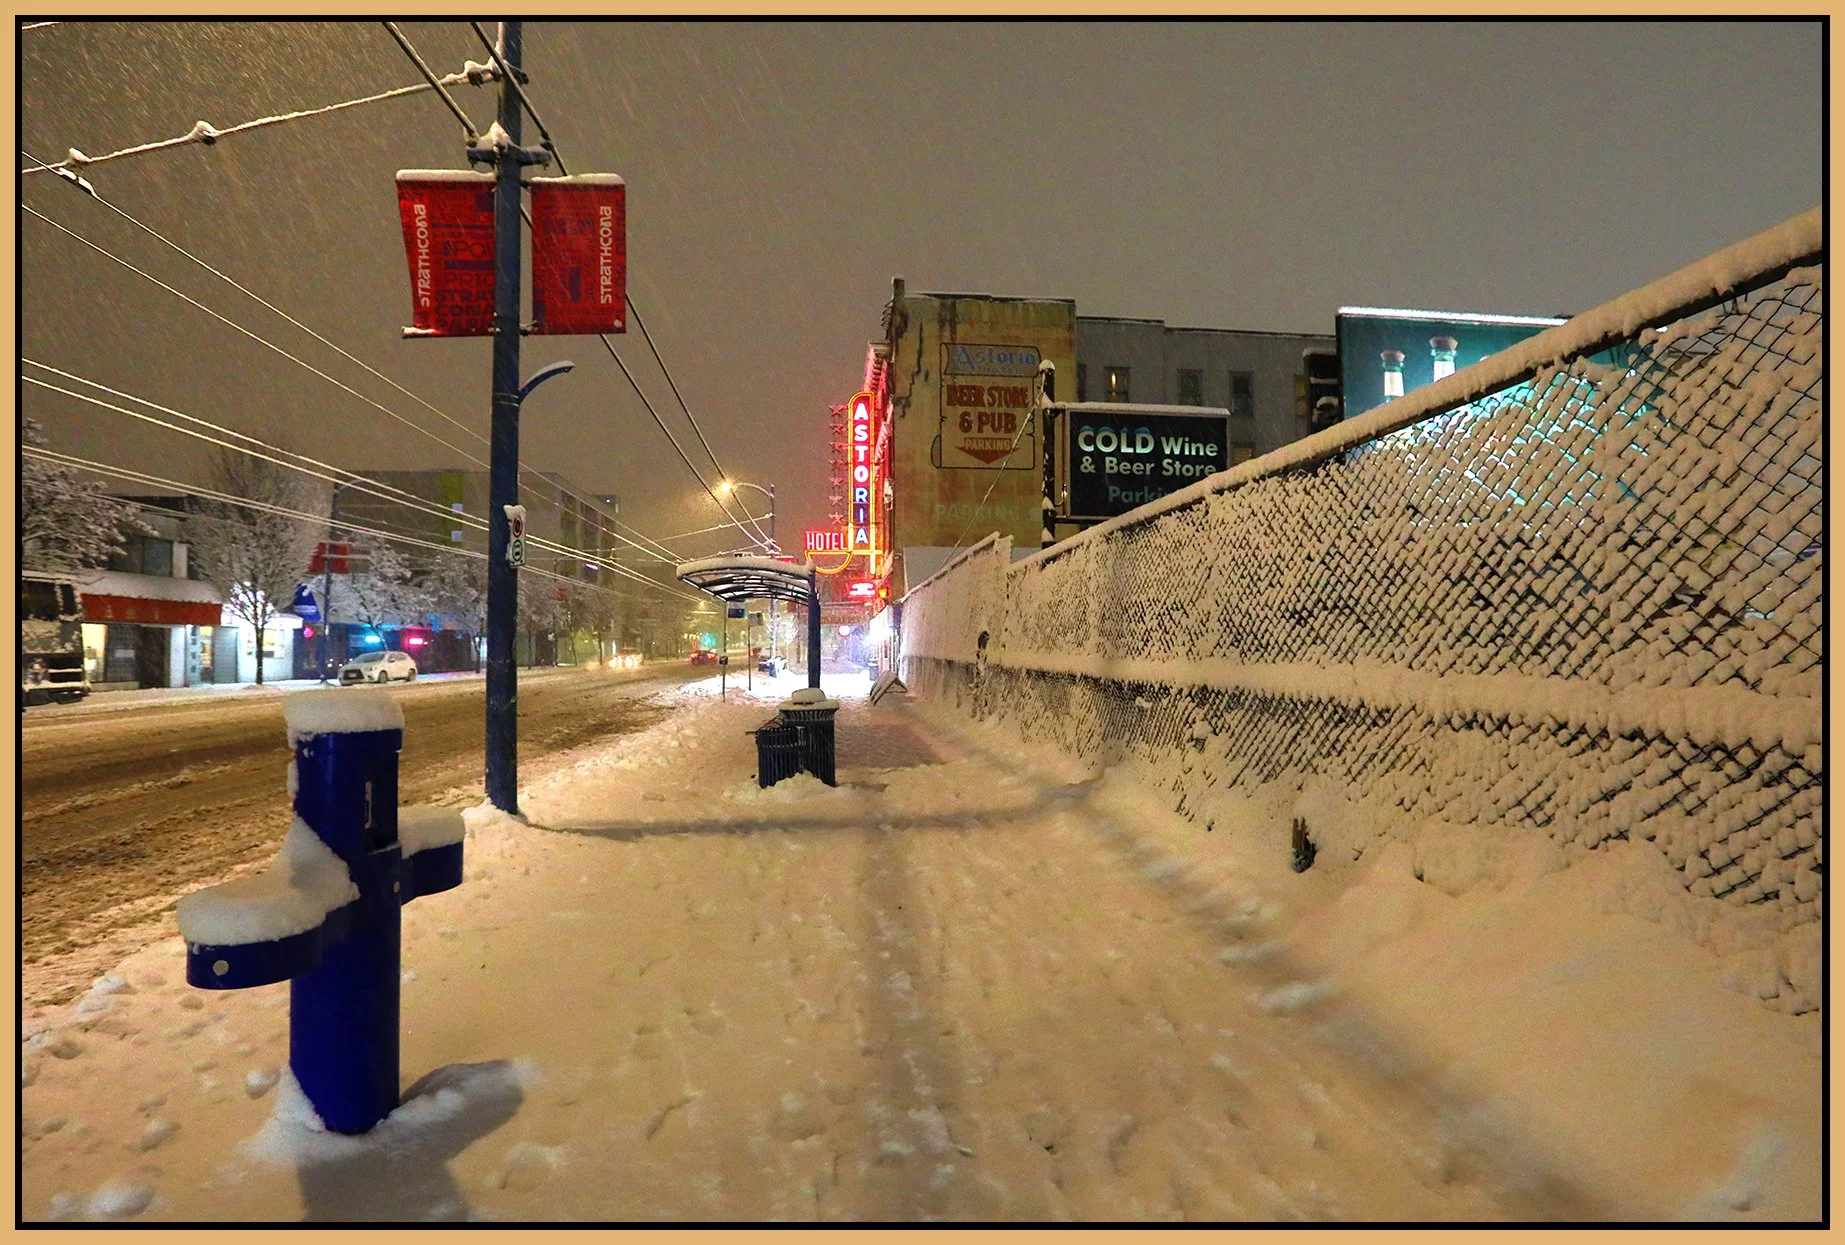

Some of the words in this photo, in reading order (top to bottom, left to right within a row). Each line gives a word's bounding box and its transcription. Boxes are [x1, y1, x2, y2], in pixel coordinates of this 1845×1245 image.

[946, 384, 985, 407] BEER
[987, 386, 1029, 408] STORE
[977, 412, 1017, 434] PUB
[964, 438, 1012, 451] PARKING
[1077, 425, 1155, 454] COLD
[1160, 436, 1219, 457] Wine
[853, 403, 869, 544] ASTORIA
[1080, 455, 1096, 474] &
[1105, 456, 1155, 475] Beer
[1161, 458, 1217, 477] Store
[806, 532, 848, 550] HOTEL
